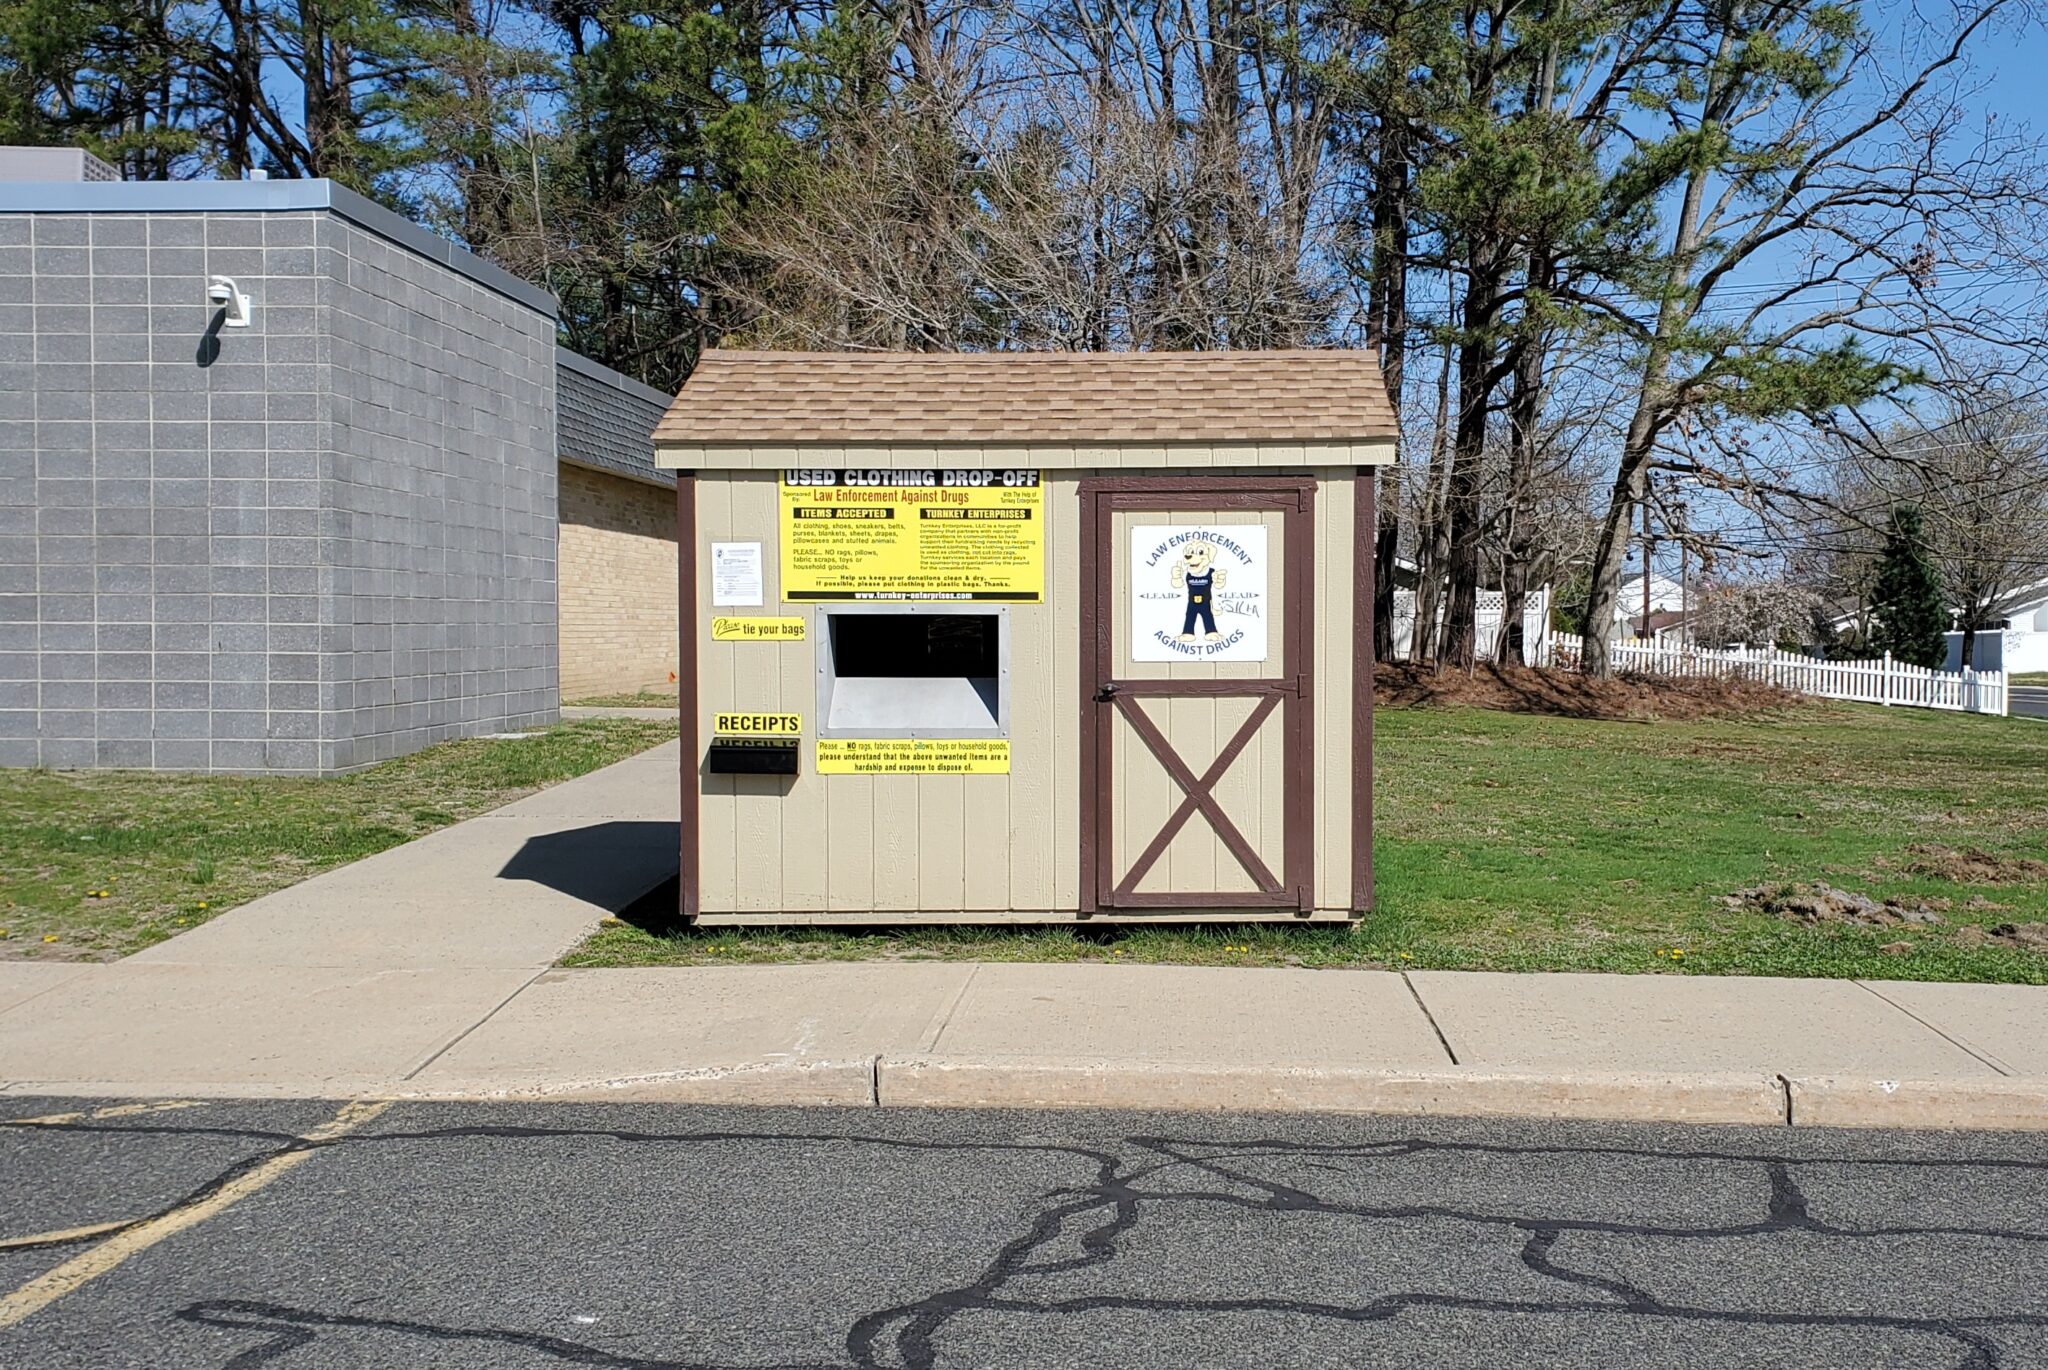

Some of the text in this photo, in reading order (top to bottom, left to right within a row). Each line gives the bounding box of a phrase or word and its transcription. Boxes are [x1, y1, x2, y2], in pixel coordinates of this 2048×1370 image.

[786, 470, 1037, 486] USED CLOTHING DROP-OFF
[814, 489, 969, 504] Law Enforcement Against Drugs
[801, 509, 886, 518] ITEMS ACCEPTED
[926, 510, 1025, 518] TURNKEY ENTERPRISES
[1145, 531, 1253, 567] LAW ENFORCEMENT
[855, 592, 972, 600] www.turnkey-enterprises.com
[743, 624, 755, 634] tie
[759, 625, 778, 636] your
[782, 624, 804, 636] bags
[1154, 629, 1244, 655] AGAINST DRUGS
[719, 716, 798, 730] RECEIPTS
[820, 742, 838, 750] Please
[858, 744, 872, 752] rags,
[874, 742, 890, 750] fabric
[892, 743, 912, 752] scraps,
[914, 743, 934, 752] pillows,
[937, 743, 949, 752] toys
[959, 742, 987, 750] household
[820, 753, 841, 762] please
[844, 753, 881, 761] understand
[883, 753, 897, 761] that
[900, 753, 910, 761] the
[913, 753, 932, 761] above
[935, 753, 967, 761] unwanted
[969, 753, 988, 761] items
[855, 763, 973, 772] hardship and expense to dispose of.
